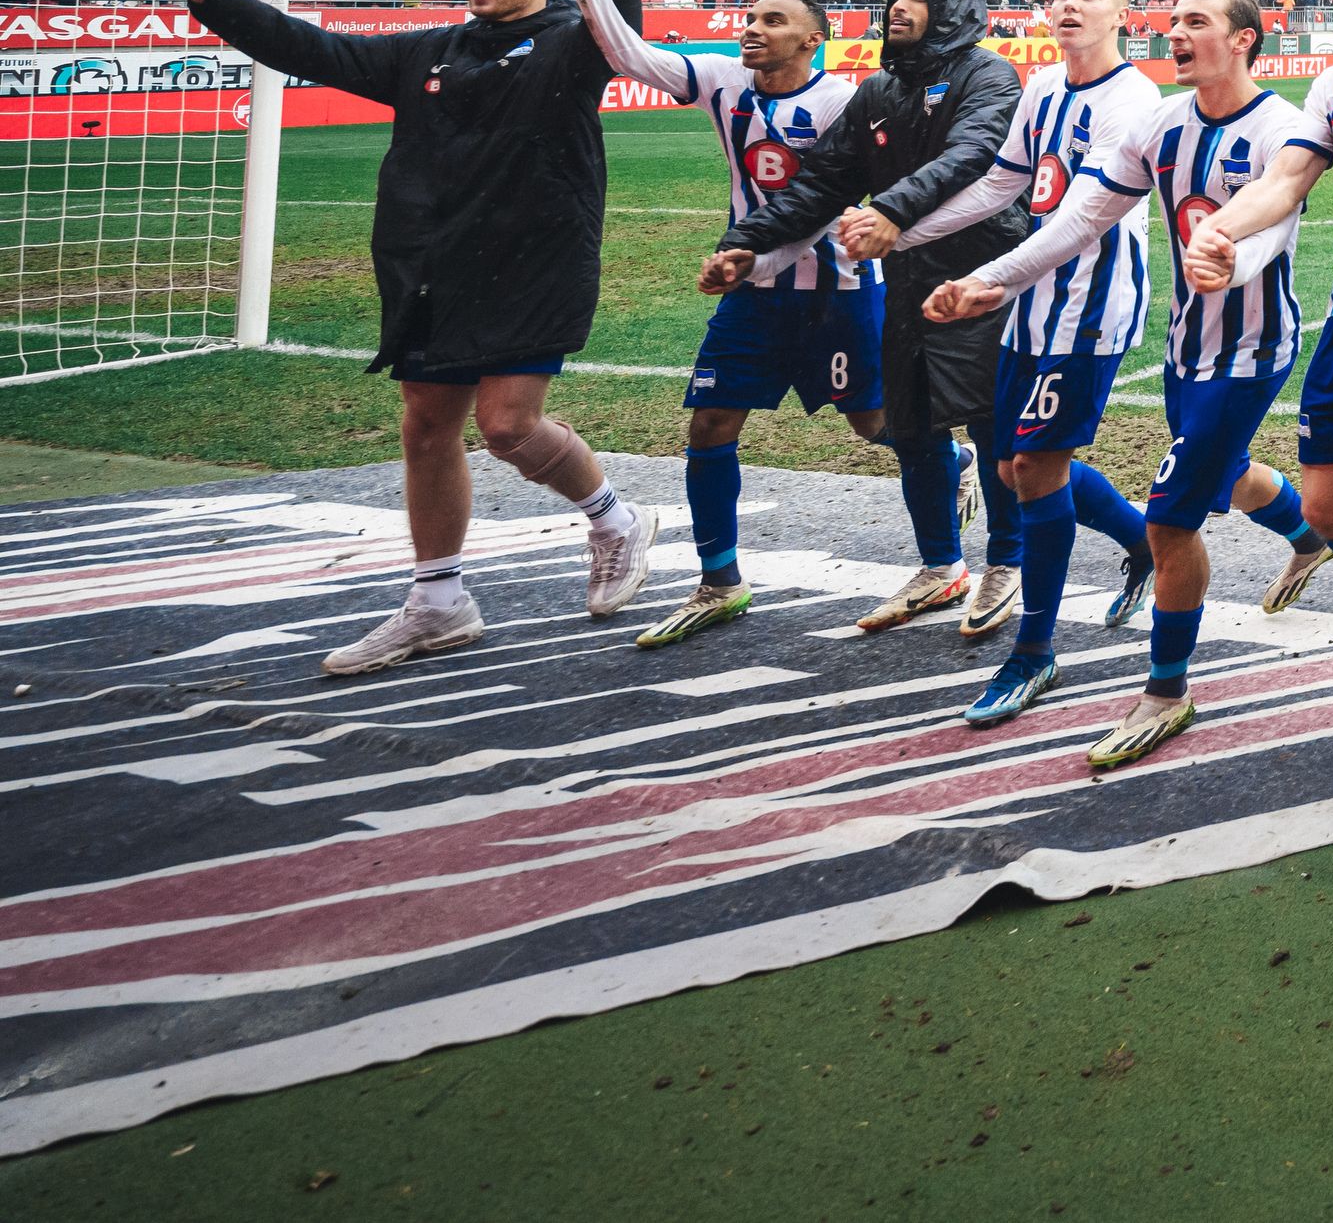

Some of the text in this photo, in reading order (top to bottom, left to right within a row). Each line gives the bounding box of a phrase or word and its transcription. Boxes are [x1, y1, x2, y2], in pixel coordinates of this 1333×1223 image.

[326, 21, 375, 34] Allgäuer
[1251, 57, 1327, 77] DICH JETZT!
[430, 80, 441, 92] B
[756, 150, 785, 181] B
[1031, 166, 1053, 203] B
[831, 351, 848, 391] 8
[1019, 372, 1063, 421] 26
[1154, 436, 1184, 484] 6
